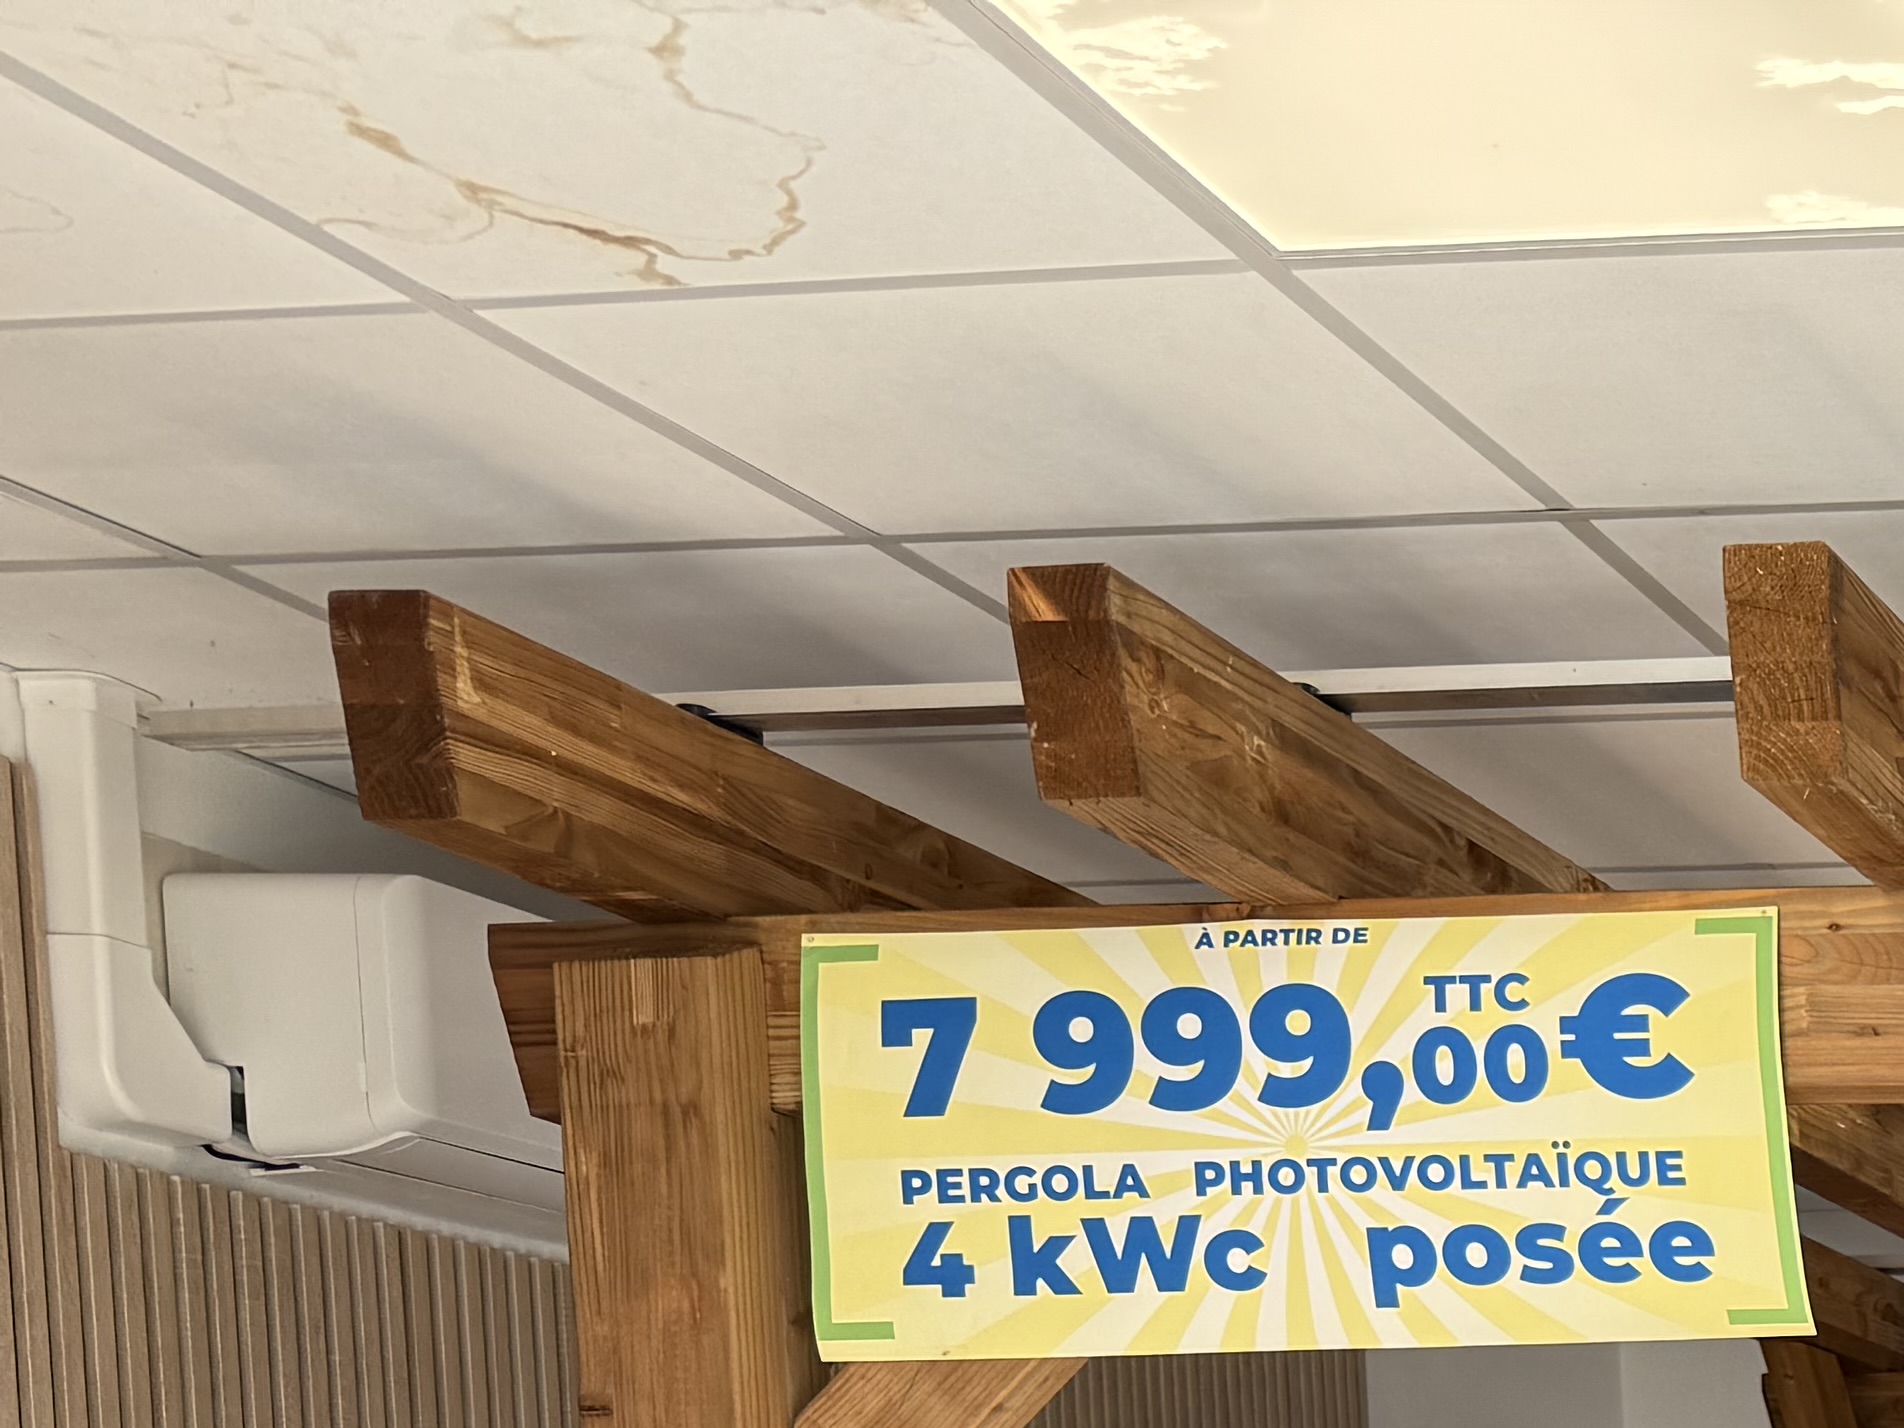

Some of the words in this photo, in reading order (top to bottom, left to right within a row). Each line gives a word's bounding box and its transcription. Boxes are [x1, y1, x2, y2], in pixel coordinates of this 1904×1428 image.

[1194, 926, 1214, 949] À
[1222, 926, 1326, 948] PARTIR
[1331, 925, 1370, 946] DE
[1423, 972, 1531, 1013] TTC
[879, 997, 978, 1118] 7
[900, 1163, 1149, 1205] PERGOLA
[1194, 1140, 1686, 1201] PHOTOVOLTAÏQUE
[902, 1220, 975, 1299] 4
[1010, 1212, 1267, 1298] kWc
[1368, 1197, 1716, 1308] posée
